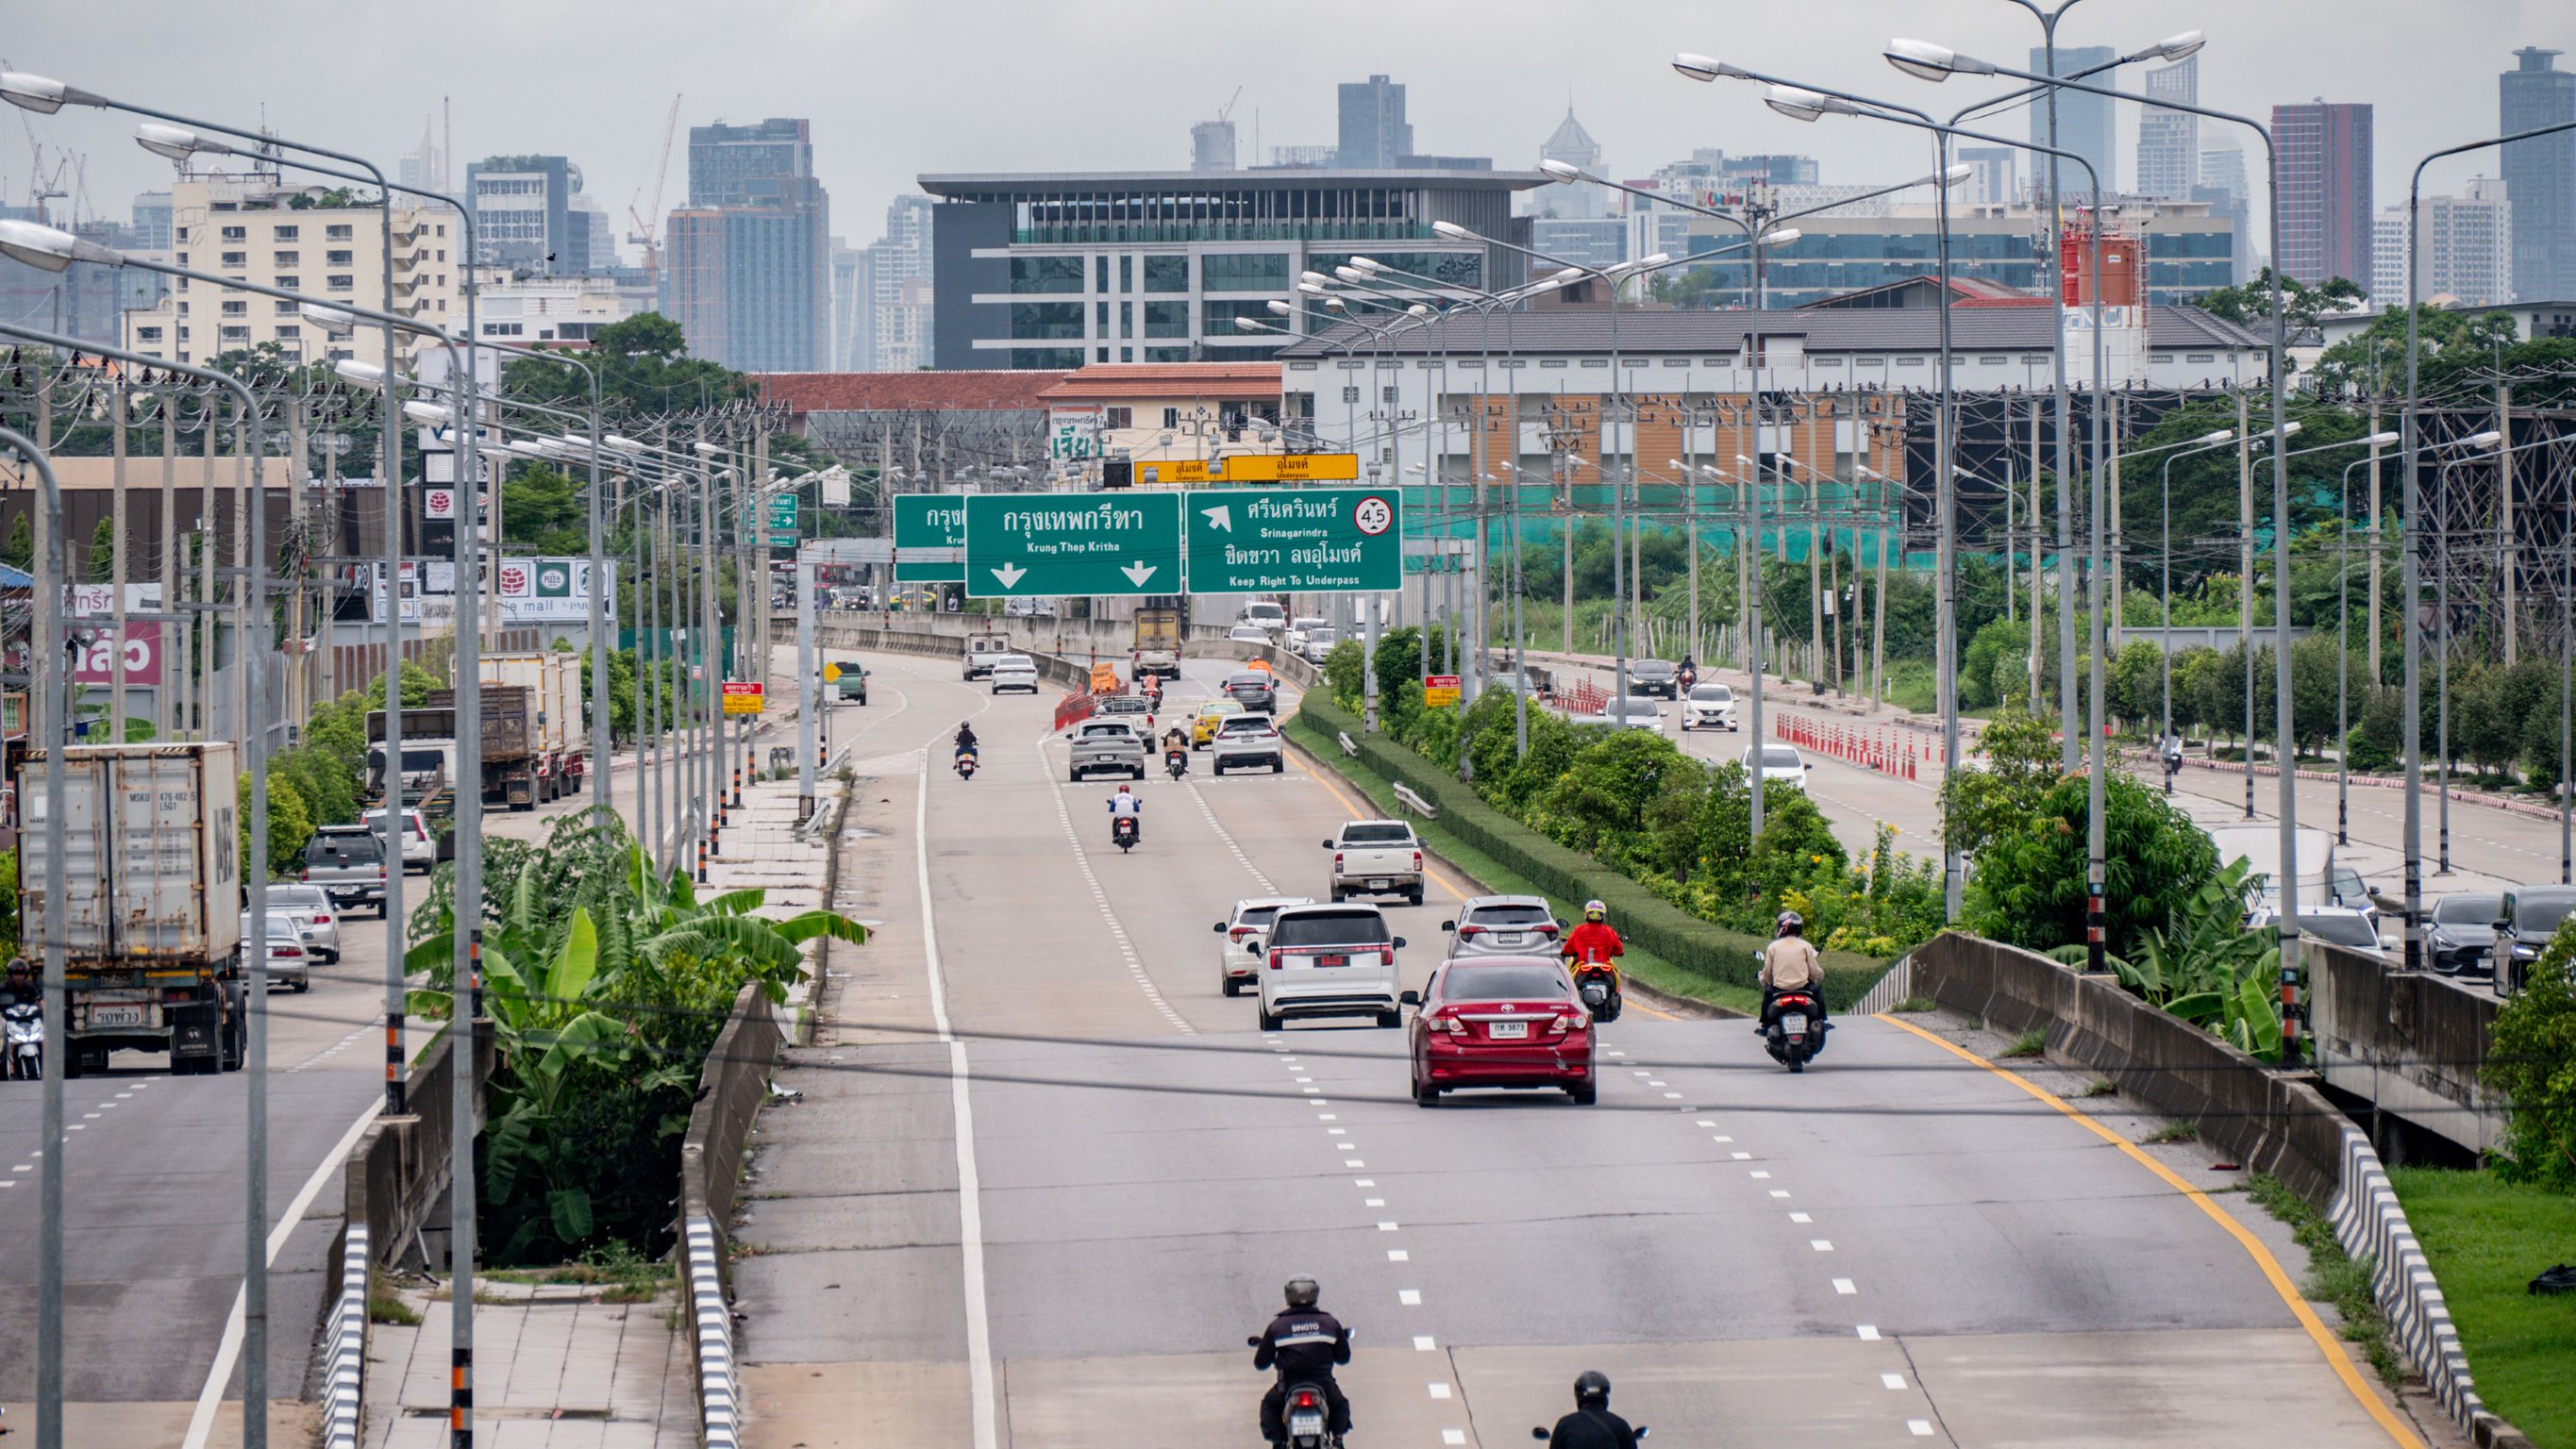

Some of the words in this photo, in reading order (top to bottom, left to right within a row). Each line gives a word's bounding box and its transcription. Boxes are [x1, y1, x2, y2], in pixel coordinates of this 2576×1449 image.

[1176, 461, 1203, 475] อุโมงค์
[1277, 458, 1310, 474] อุโมงค์
[1277, 472, 1310, 480] Underpass
[1247, 497, 1339, 518] ศรีนครินทร์
[1004, 503, 1144, 539] กรุงเทพกรีฑา
[1361, 508, 1386, 524] 4.5
[1261, 528, 1329, 540] Srinagarindra
[1027, 542, 1057, 555] Krung
[1060, 542, 1085, 554] Thep
[1088, 541, 1120, 552] Kritha
[1291, 541, 1363, 569] ลงอุโมงค์
[544, 575, 561, 584] PIZZA
[1229, 576, 1255, 588] Keep
[1261, 575, 1286, 588] Right
[1290, 575, 1301, 585] To
[1306, 575, 1360, 587] Underpass
[524, 600, 553, 611] mall
[129, 793, 150, 802] MSKU
[175, 792, 188, 802] 482
[159, 802, 176, 811] L5G1
[97, 1008, 139, 1024] รถพ่วง
[1291, 1323, 1320, 1333] SINGTO
